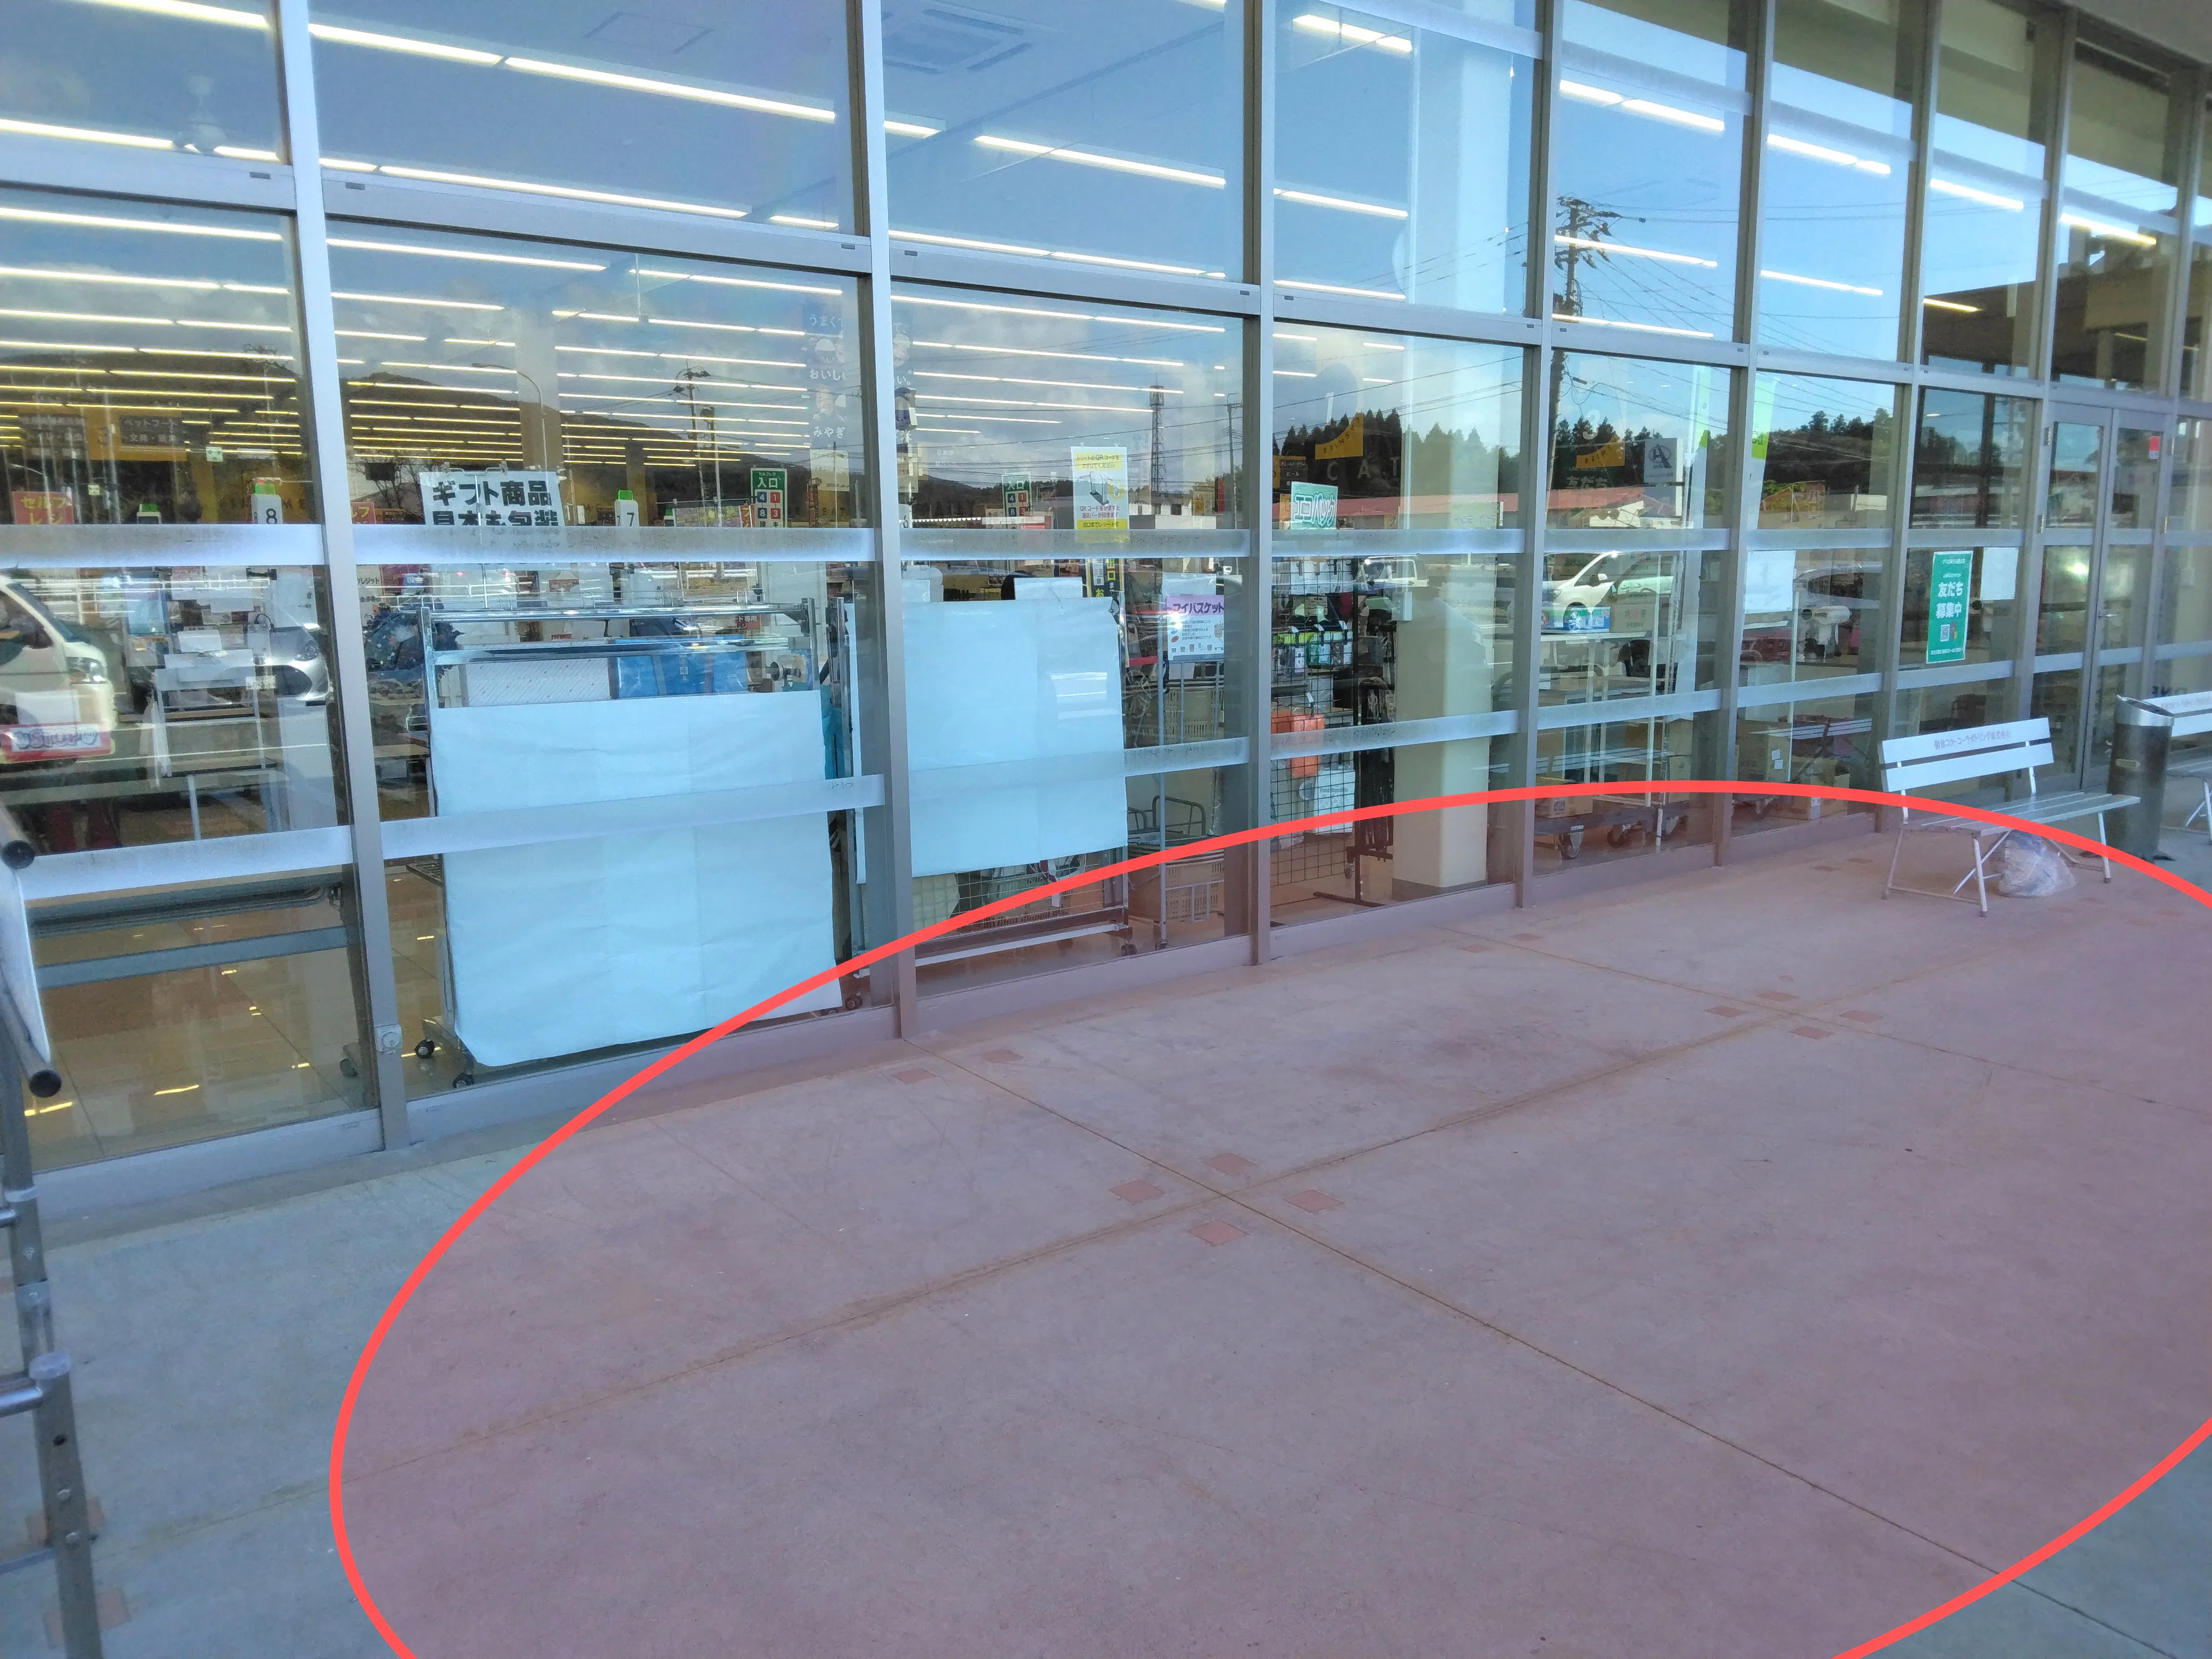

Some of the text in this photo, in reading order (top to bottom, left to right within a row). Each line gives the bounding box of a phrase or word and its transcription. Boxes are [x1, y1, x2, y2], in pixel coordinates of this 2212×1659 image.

[757, 477, 778, 489] 入口
[432, 480, 552, 507] ギフト商品
[265, 508, 278, 524] 8
[626, 512, 635, 527] 7
[1937, 581, 1964, 598] 友だち
[1936, 601, 1962, 618] 募集中
